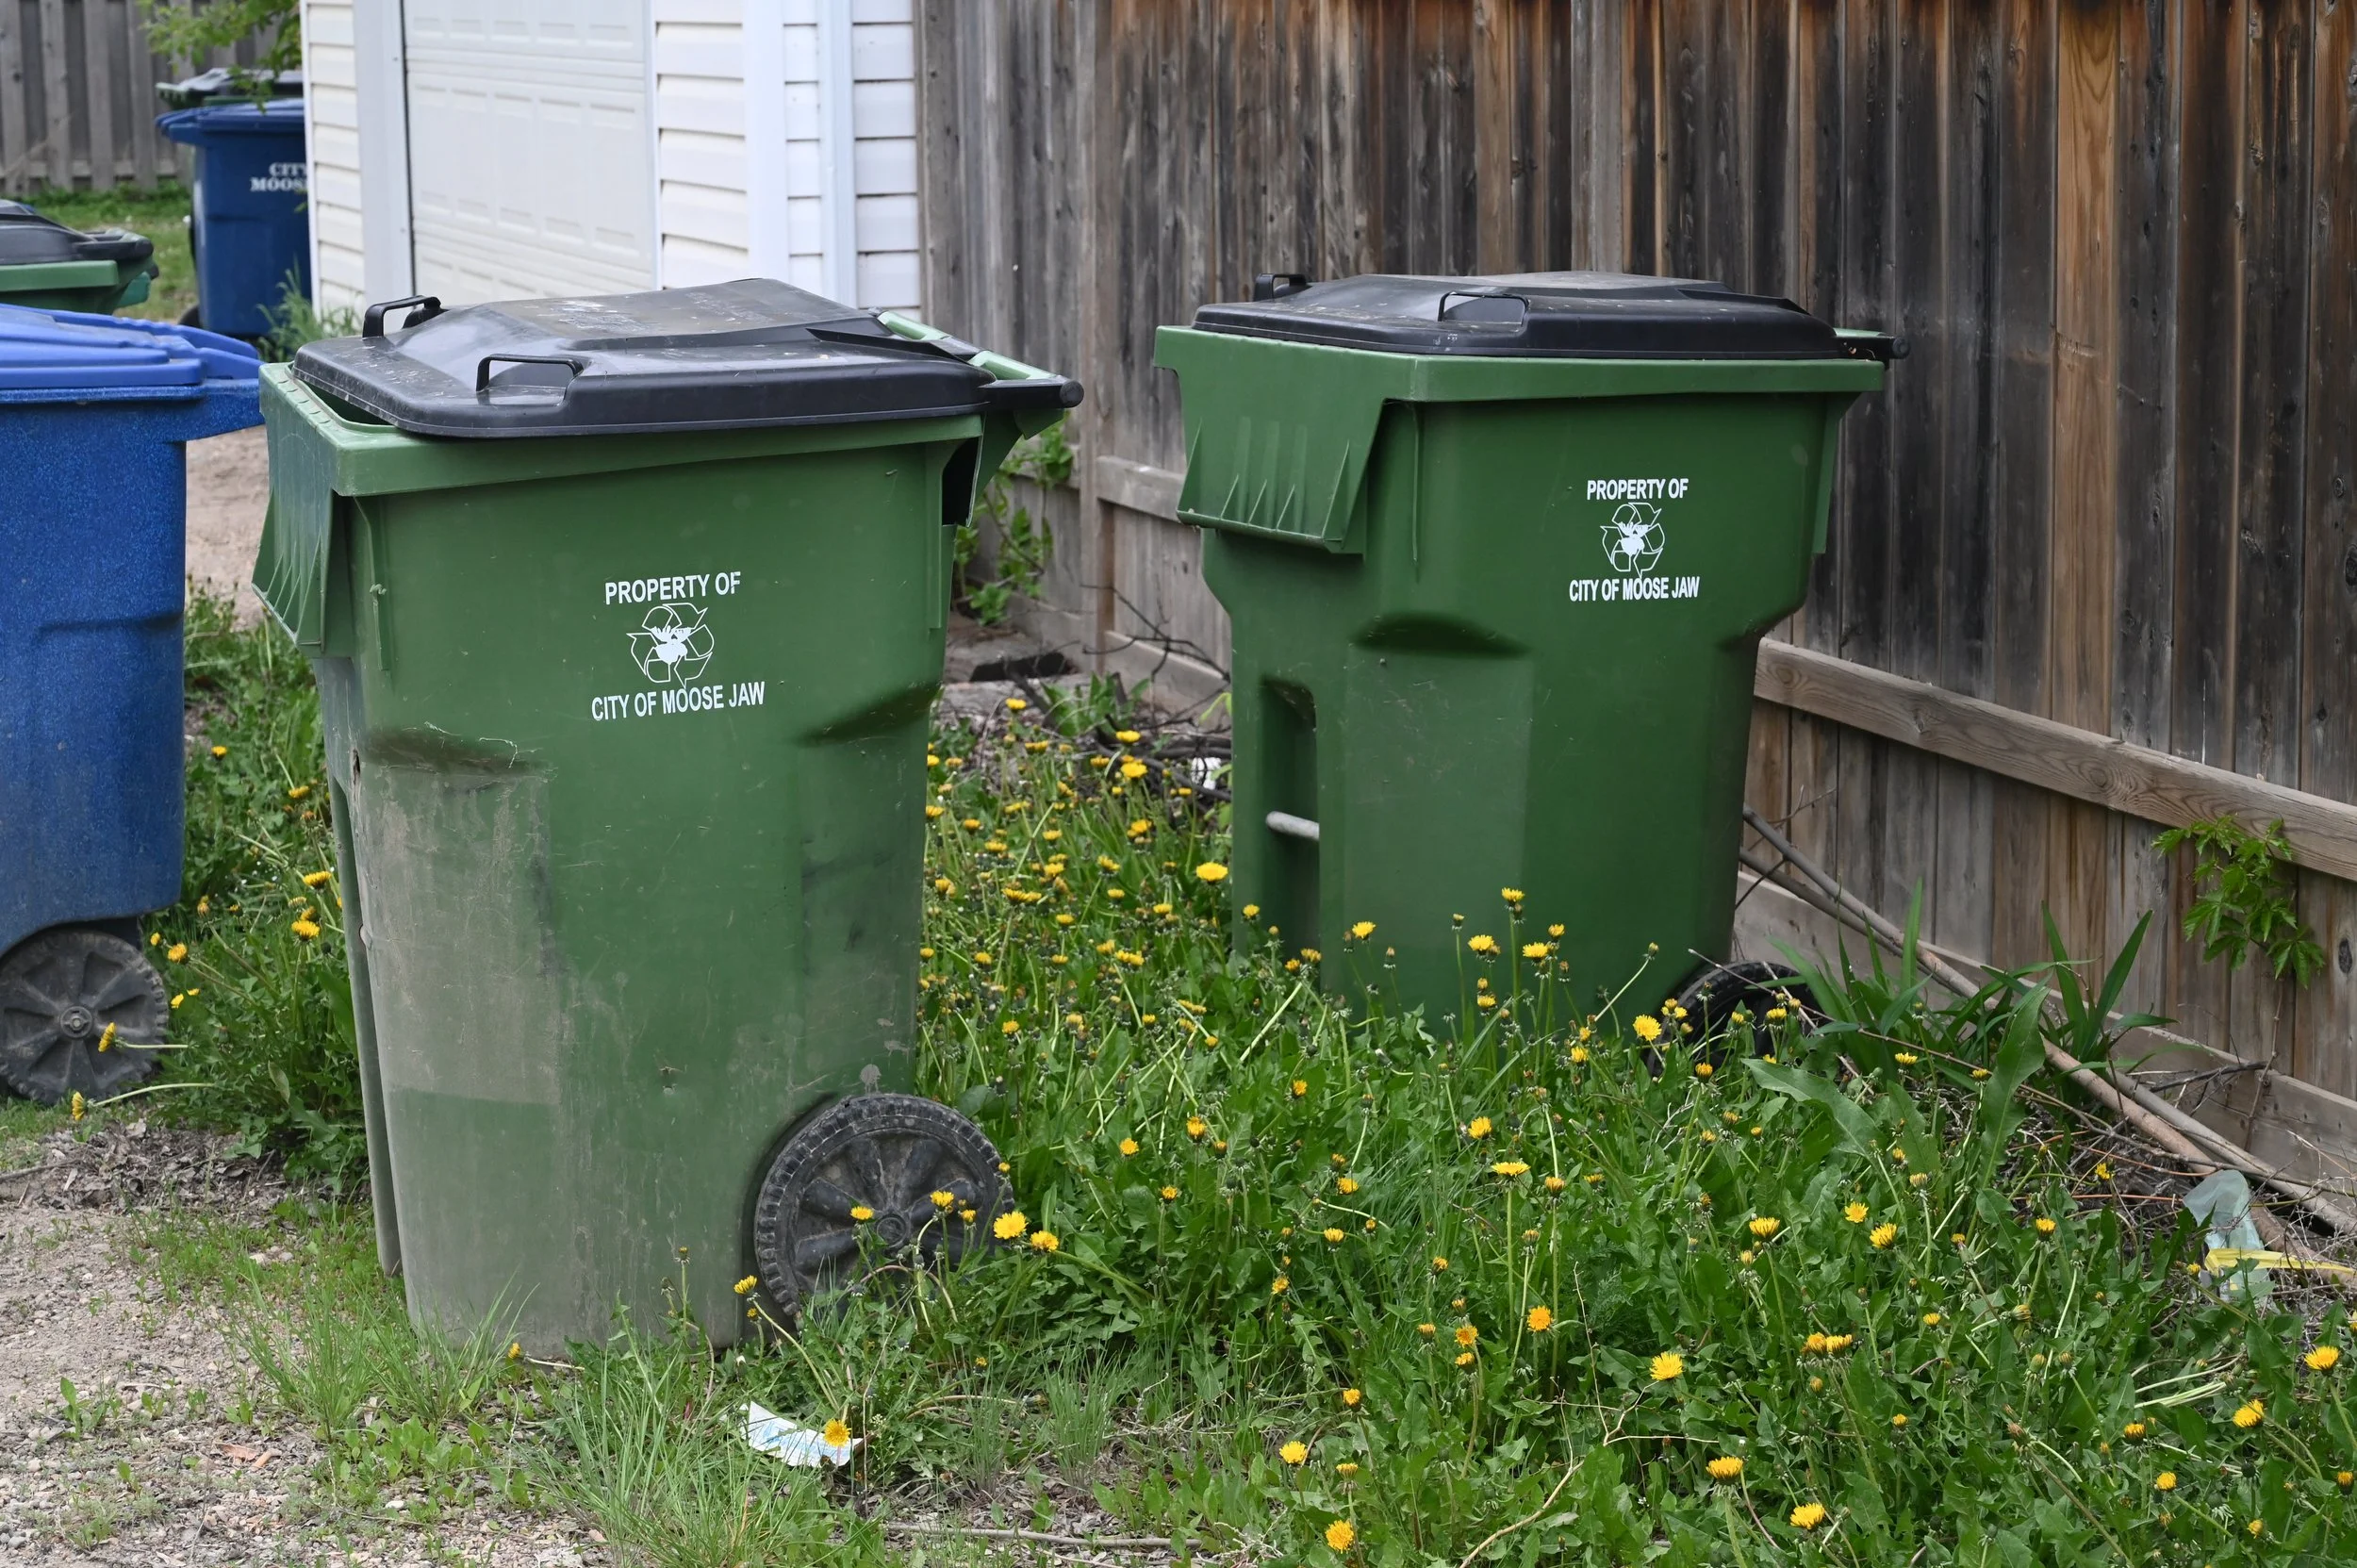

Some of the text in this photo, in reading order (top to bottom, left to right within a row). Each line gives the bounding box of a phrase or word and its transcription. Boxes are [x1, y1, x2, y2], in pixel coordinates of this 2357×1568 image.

[250, 176, 307, 191] MOOS
[1587, 478, 1689, 500] PROPERTY OF
[605, 571, 741, 604] PROPERTY OF
[1569, 576, 1700, 602] CITY OF MOOSE JAW
[591, 682, 765, 720] CITY OF MOOSE JAW
